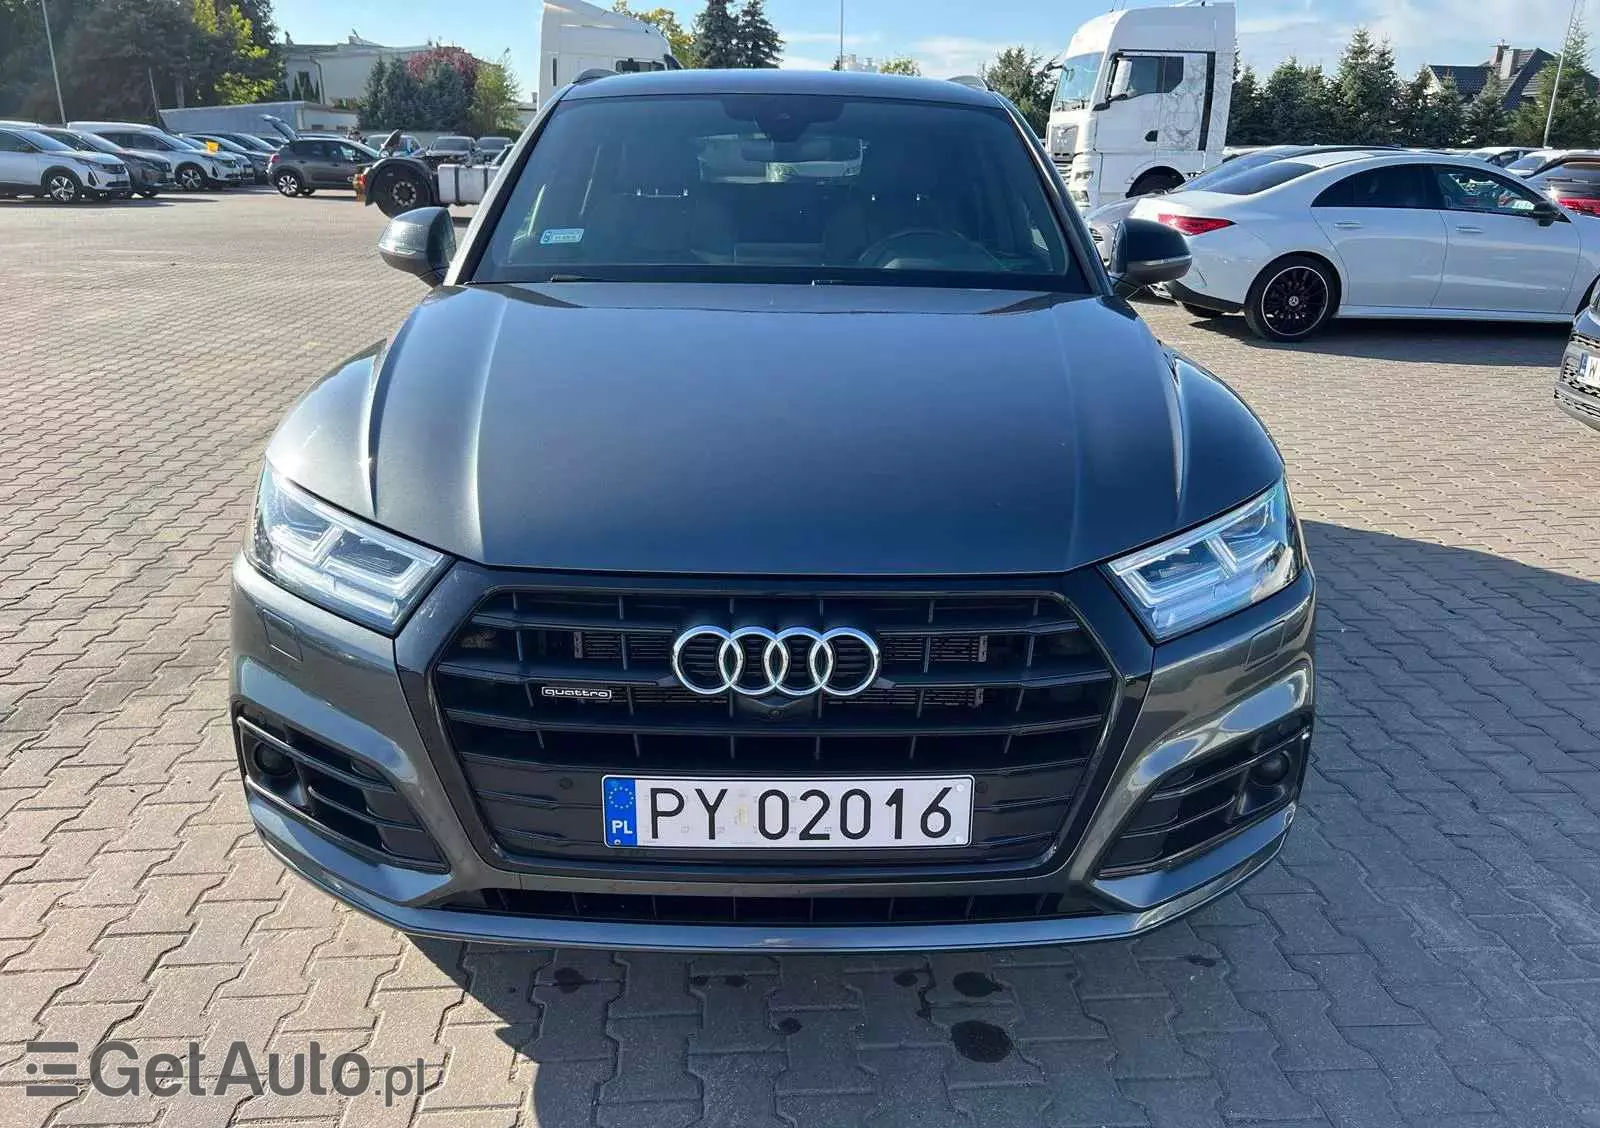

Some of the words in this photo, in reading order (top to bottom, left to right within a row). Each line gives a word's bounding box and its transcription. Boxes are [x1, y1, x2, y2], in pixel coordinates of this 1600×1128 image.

[543, 688, 609, 698] quattro
[650, 787, 728, 840] PY
[758, 787, 953, 841] 02016
[611, 820, 633, 834] PL
